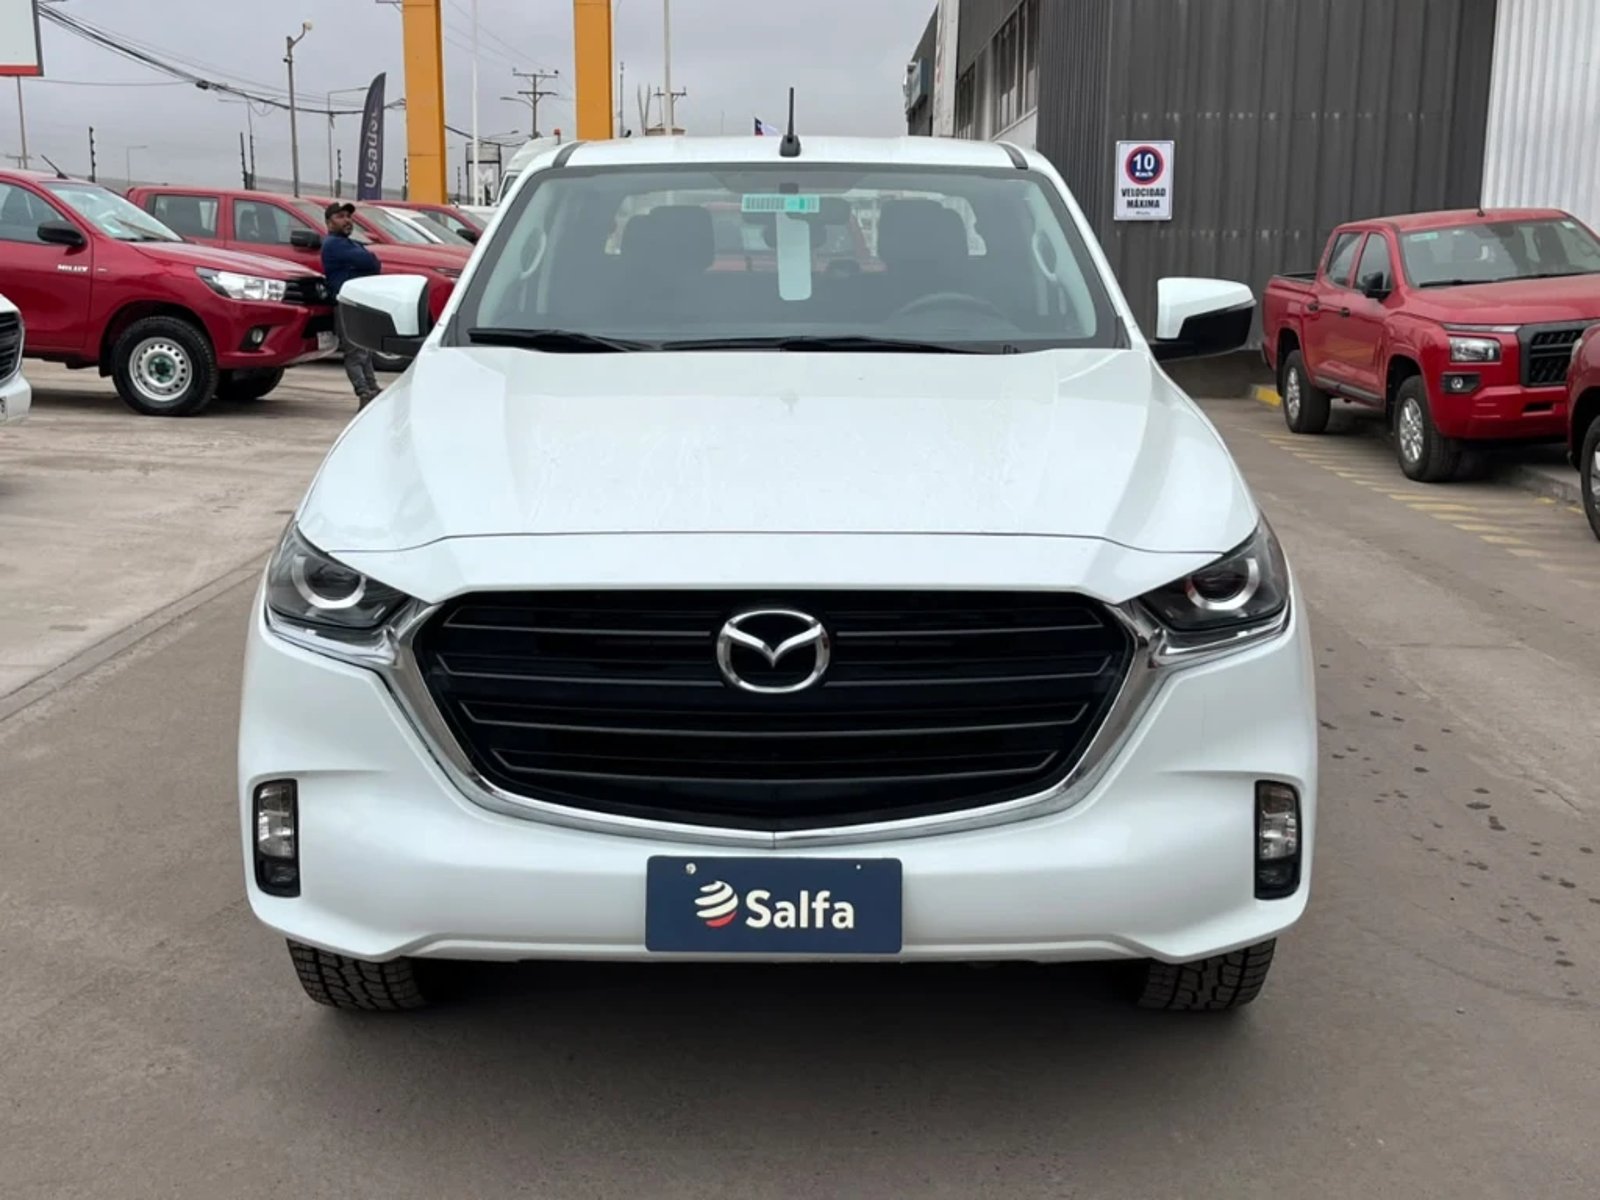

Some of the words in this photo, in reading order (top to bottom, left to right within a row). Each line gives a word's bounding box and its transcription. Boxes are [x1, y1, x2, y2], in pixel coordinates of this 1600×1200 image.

[1133, 153, 1155, 170] 10
[1121, 187, 1166, 197] VELOCIDAD
[1126, 198, 1160, 208] MÁXIMA
[745, 889, 855, 929] Salfa
